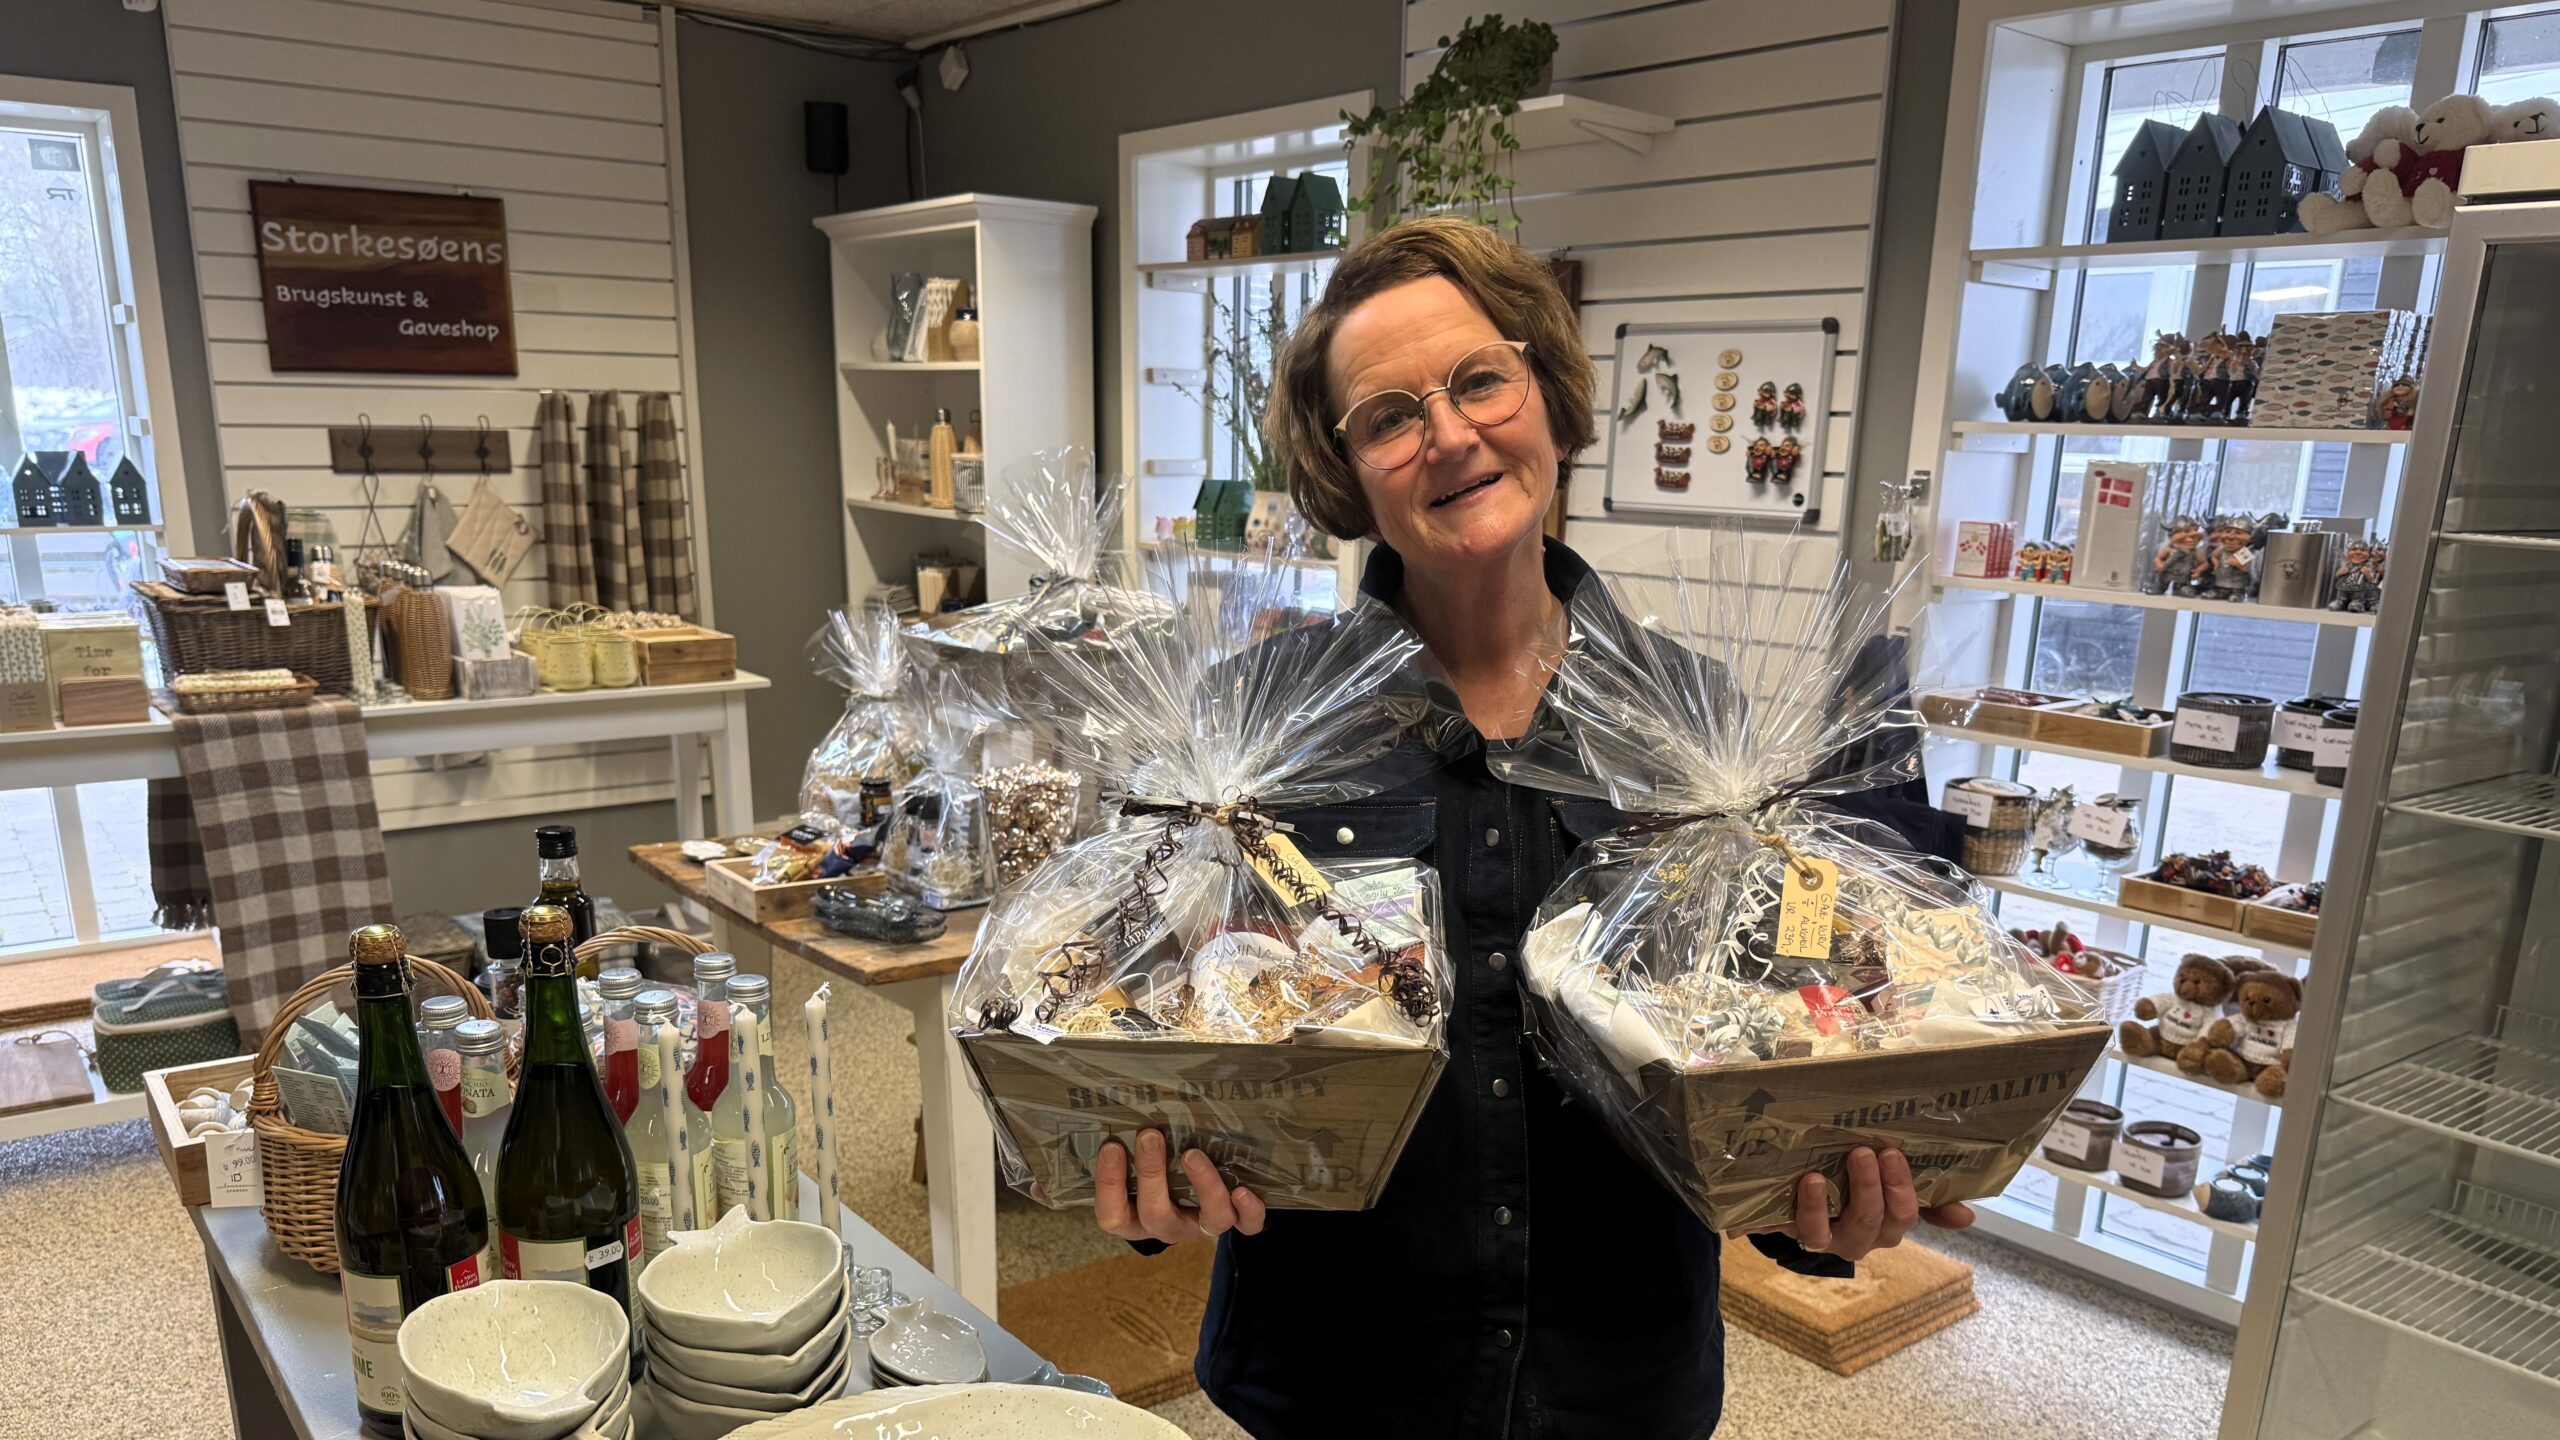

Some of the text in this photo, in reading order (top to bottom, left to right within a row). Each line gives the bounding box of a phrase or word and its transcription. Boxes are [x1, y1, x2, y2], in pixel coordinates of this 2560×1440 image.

[261, 221, 503, 265] Storkesøens
[275, 285, 429, 308] Brugskunst &
[399, 319, 500, 341] Gaveshop
[75, 645, 114, 658] Time
[232, 1155, 256, 1169] 99.00
[599, 1244, 622, 1260] 39.00
